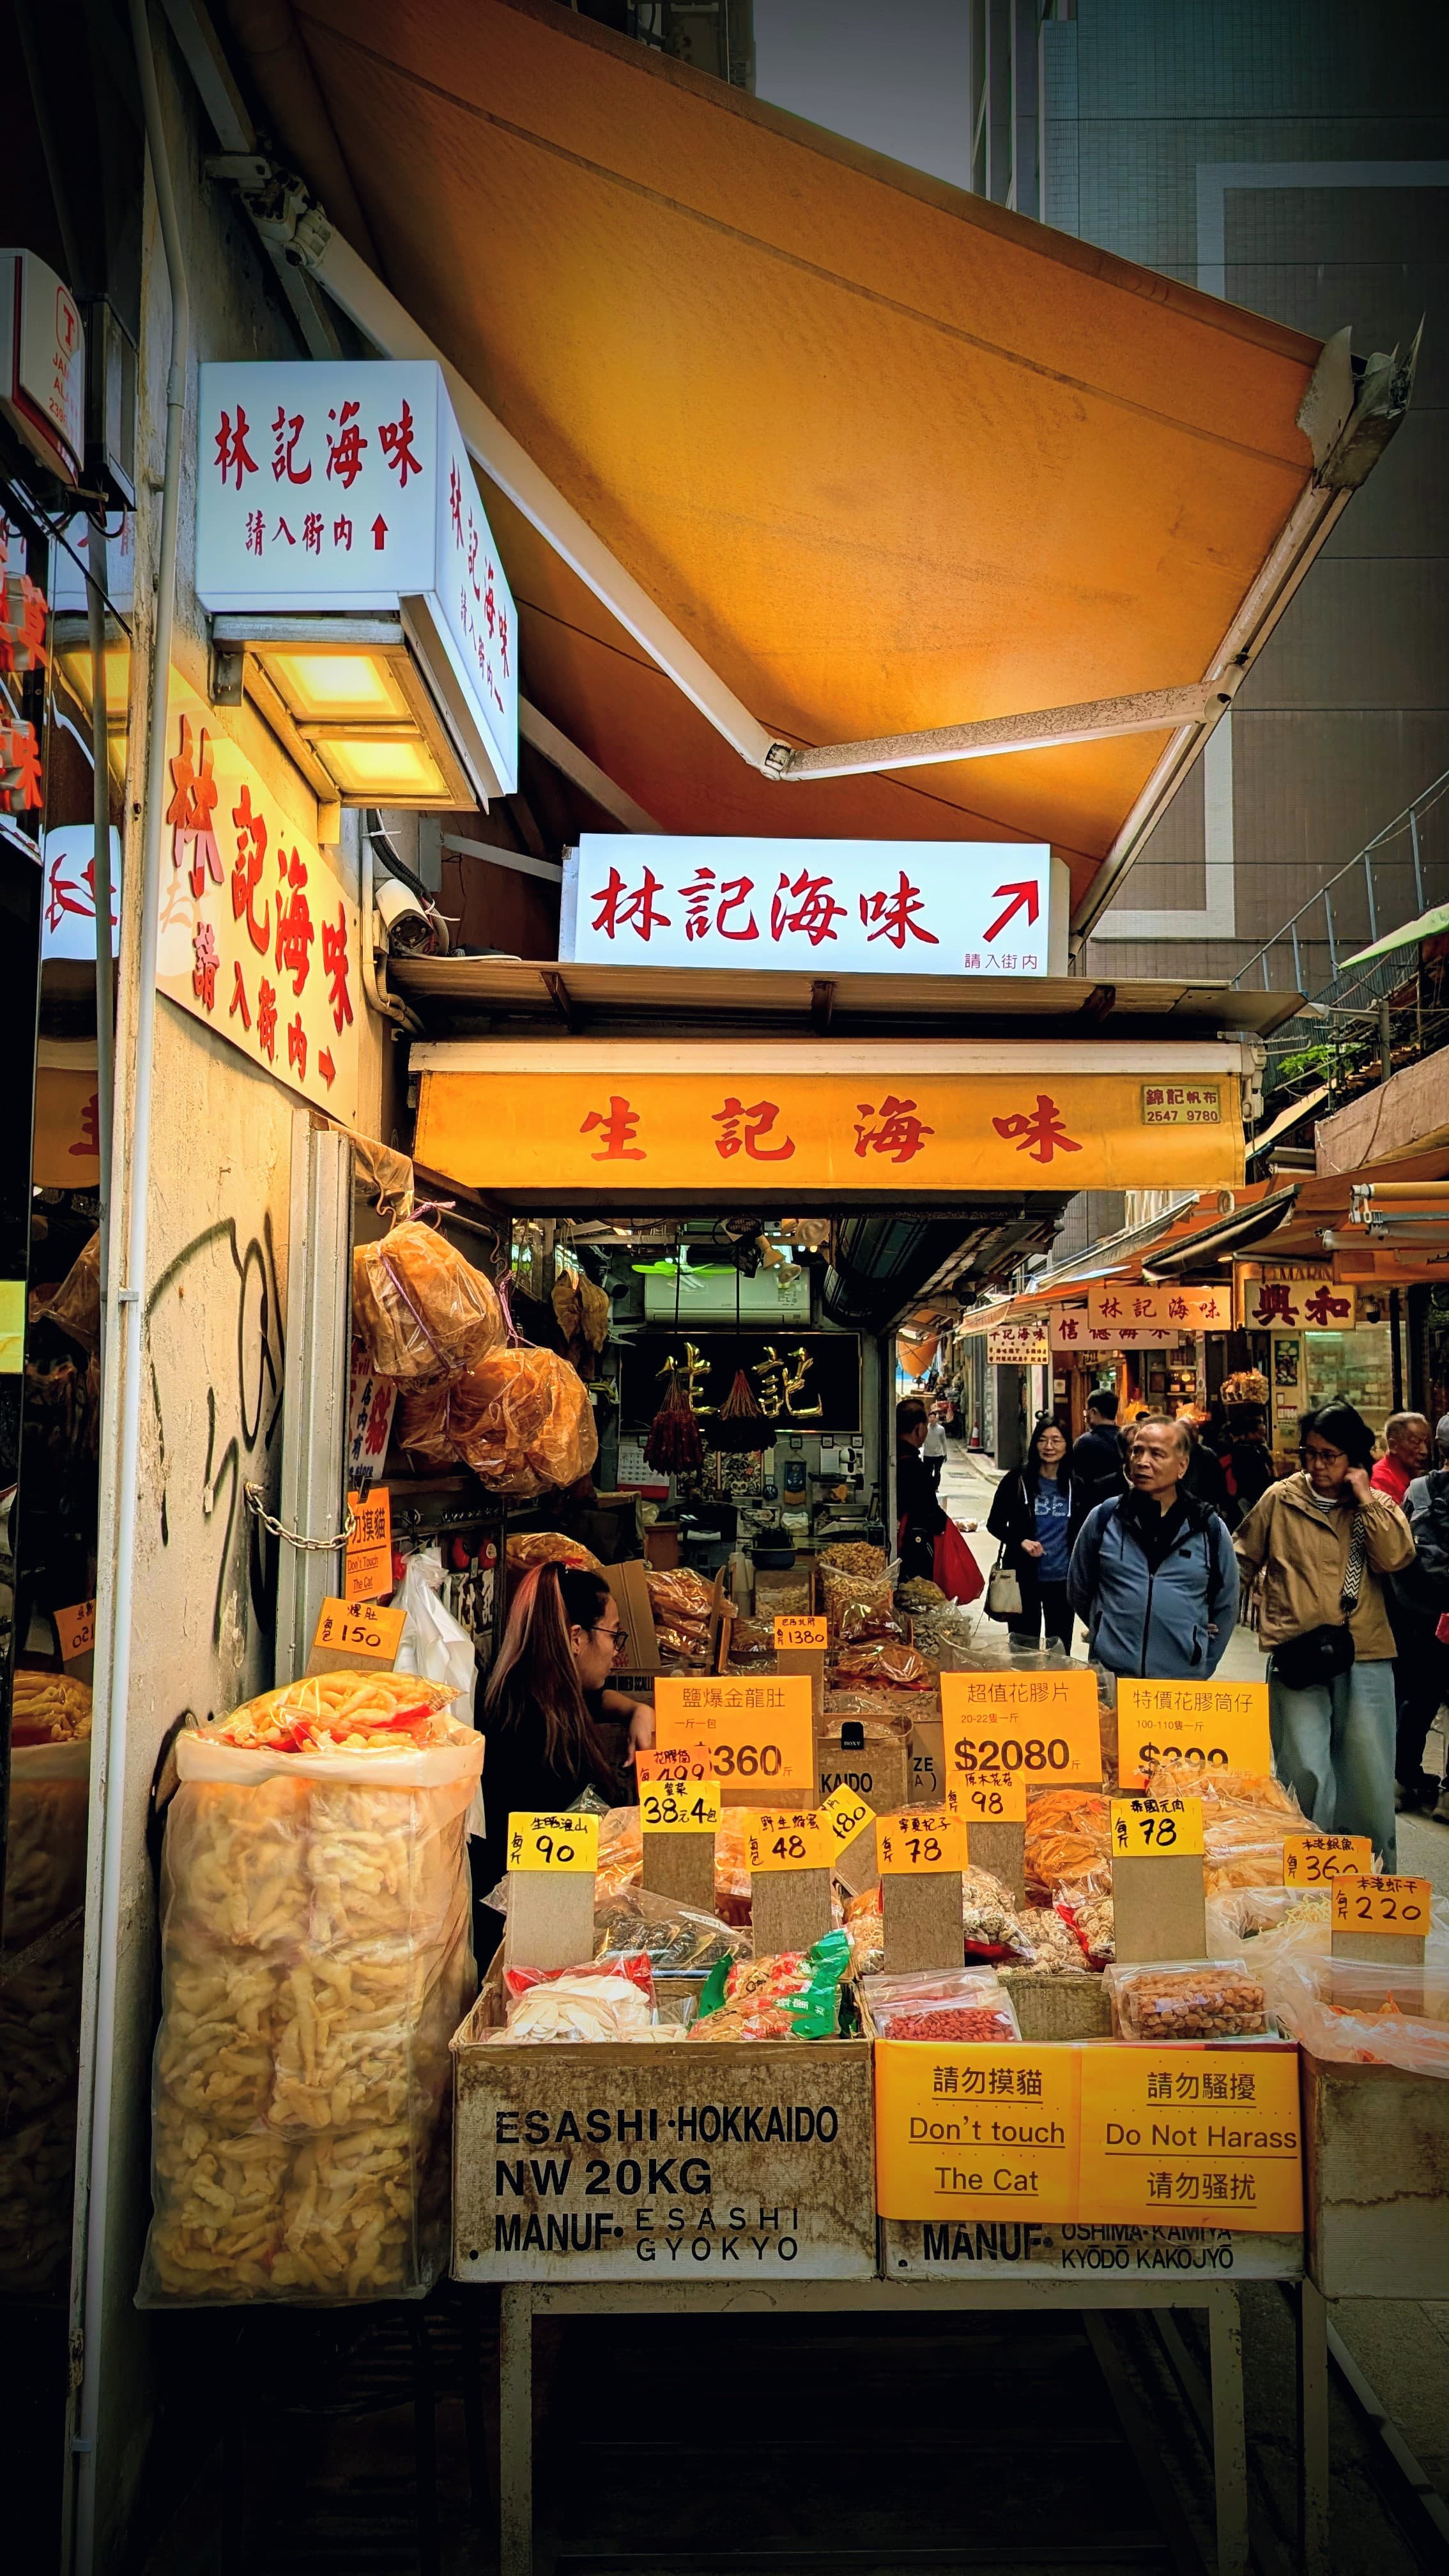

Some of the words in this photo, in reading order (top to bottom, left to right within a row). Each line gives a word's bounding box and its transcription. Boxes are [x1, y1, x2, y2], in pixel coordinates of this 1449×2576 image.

[213, 399, 422, 491] 林記海味
[166, 713, 353, 1036] 林記海味
[590, 865, 939, 949] 林記海味
[1146, 1089, 1217, 1105] 錦記帆布
[579, 1094, 1083, 1163] 生記海味
[1147, 1110, 1178, 1122] 2547
[1186, 1110, 1218, 1121] 9780
[1099, 1296, 1221, 1320] 林記海味
[1252, 1284, 1351, 1327] 興和
[364, 1555, 379, 1567] Touch
[353, 1579, 363, 1591] The
[364, 1575, 373, 1588] Cat
[342, 1625, 381, 1646] 150
[788, 1630, 825, 1644] 1380
[682, 1688, 786, 1708] 鹽爆金龍肚
[967, 1683, 1069, 1704] 超值花膠片
[1133, 1689, 1254, 1713] 特價花膠筒仔
[675, 1719, 716, 1729] 一斤一包
[913, 1757, 933, 1772] ZE
[954, 1736, 1070, 1771] $2080
[1070, 1760, 1082, 1770] 斤
[971, 1791, 1004, 1814] 98
[1139, 1818, 1177, 1846] 78
[536, 1835, 574, 1864] 90
[772, 1835, 806, 1860] 48
[905, 1837, 942, 1864] 78
[1356, 1896, 1422, 1920] 220
[933, 2066, 1043, 2096] 請勿摸貓
[1147, 2073, 1256, 2102] 請勿騷擾
[496, 2108, 658, 2144] ESASHI
[991, 2120, 1065, 2144] touch
[1106, 2123, 1141, 2145] Do
[1152, 2124, 1197, 2147] Not
[1208, 2126, 1298, 2149] Harass
[495, 2159, 572, 2196] NW
[585, 2158, 712, 2195] 20KG
[935, 2166, 983, 2191] The
[993, 2168, 1039, 2191] Cat
[1147, 2172, 1256, 2202] 请勿骚扰
[636, 2207, 799, 2230] ESASHI
[636, 2237, 799, 2262] GYOKYO
